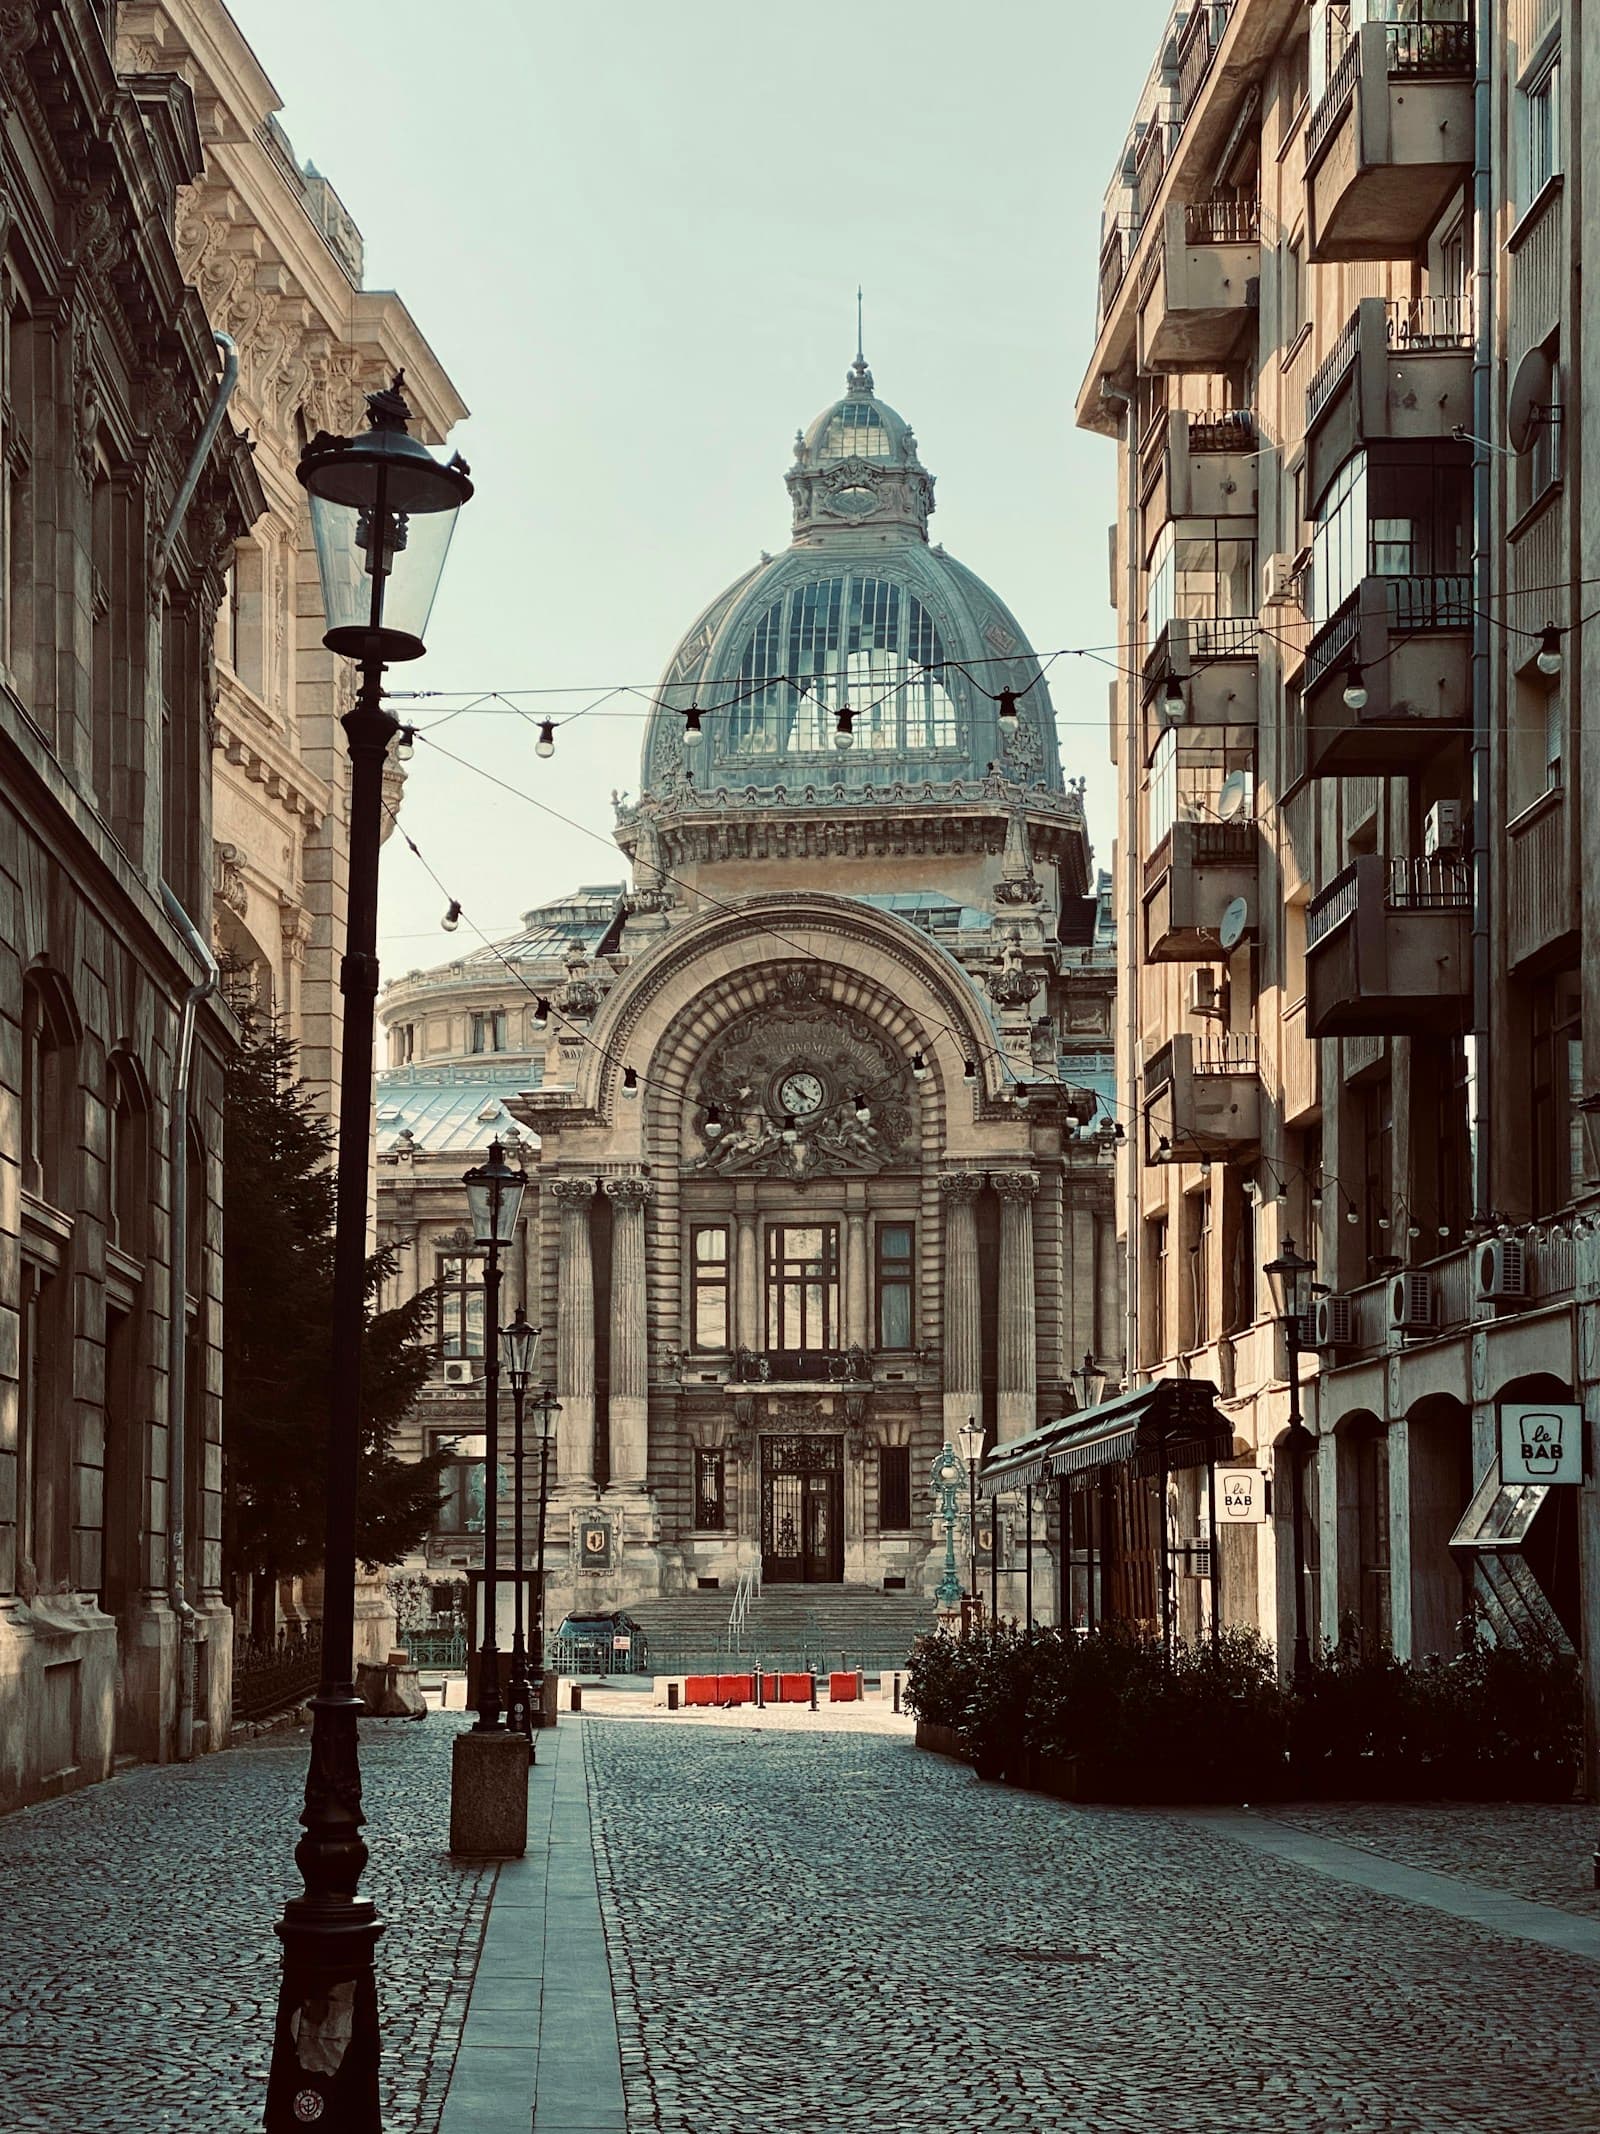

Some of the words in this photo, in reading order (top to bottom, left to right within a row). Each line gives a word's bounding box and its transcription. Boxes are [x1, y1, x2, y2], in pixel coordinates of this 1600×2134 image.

[1532, 1425, 1552, 1443] le
[1521, 1444, 1563, 1459] BAB
[1232, 1482, 1245, 1495] le
[1225, 1496, 1252, 1506] BAB
